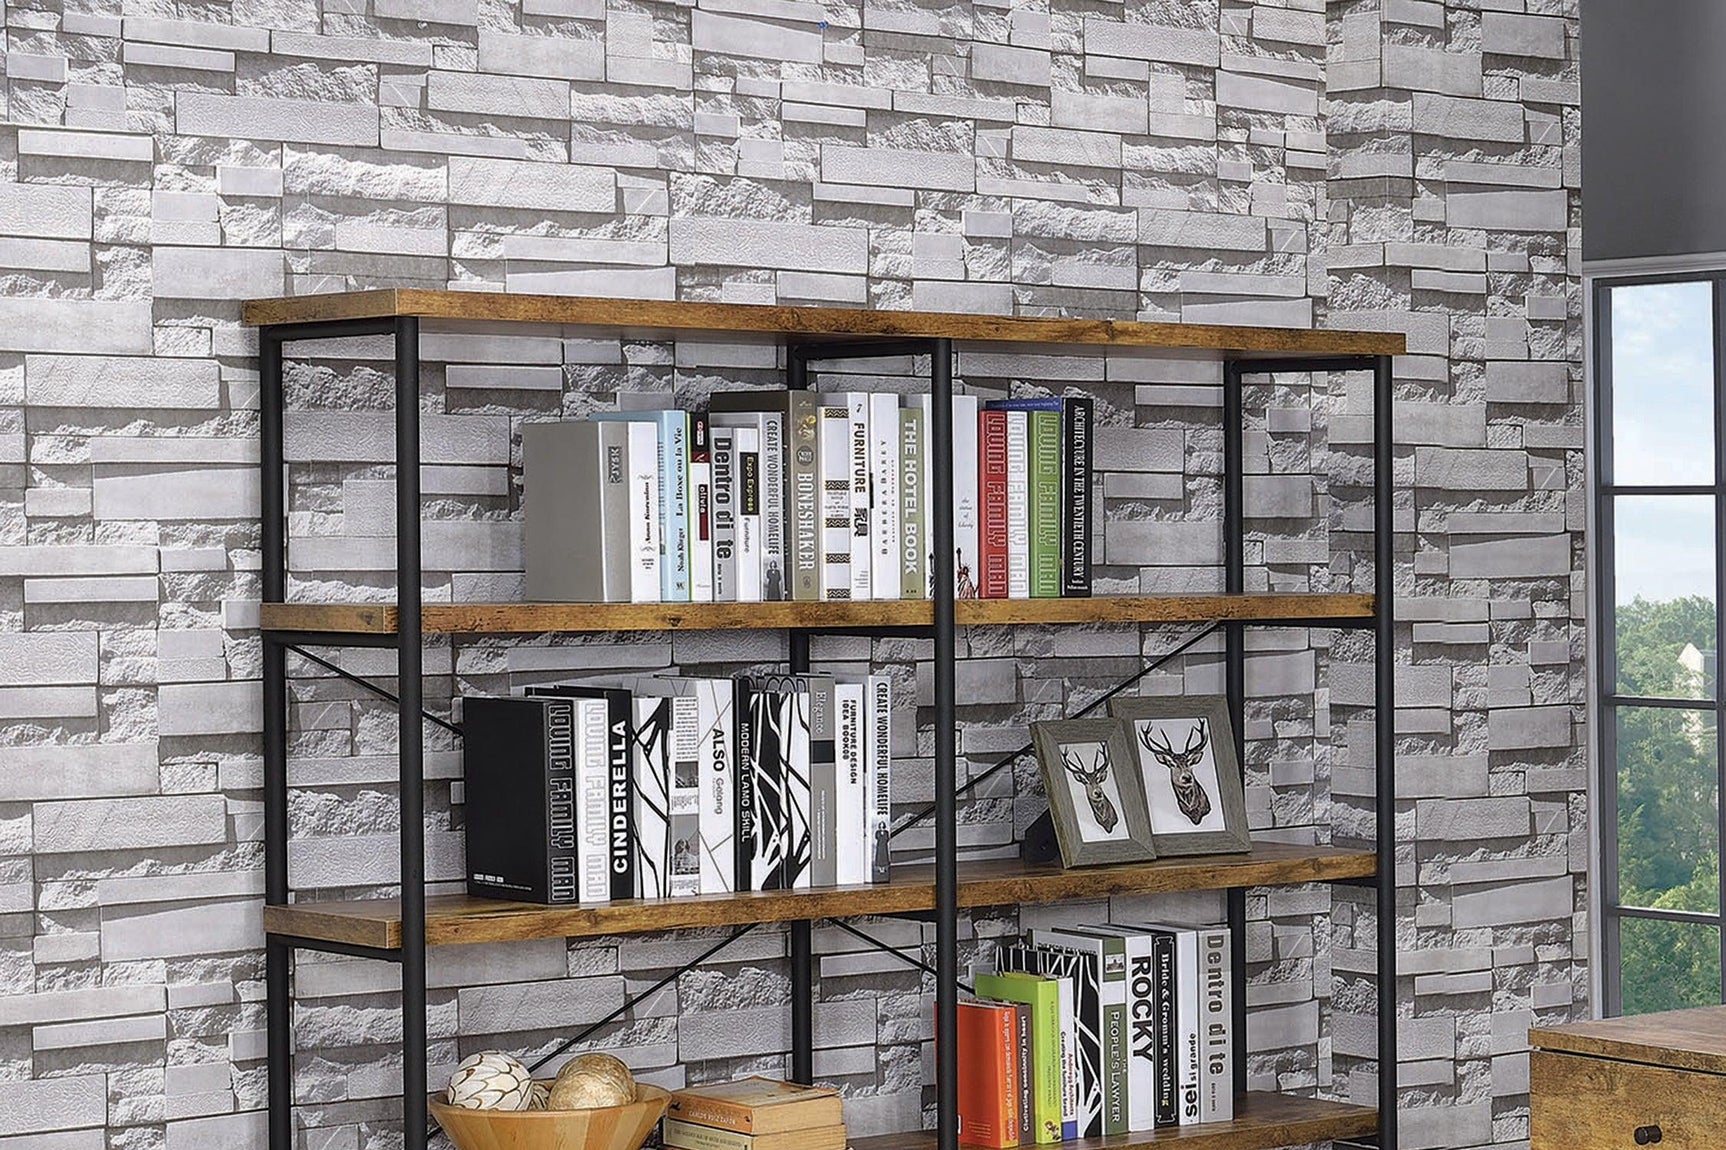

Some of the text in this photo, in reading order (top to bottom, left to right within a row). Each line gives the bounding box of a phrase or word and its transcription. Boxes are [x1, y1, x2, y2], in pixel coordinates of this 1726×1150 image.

[854, 422, 866, 494] FURNITURE
[904, 419, 917, 455] THE
[674, 428, 683, 516] La Boxe ou la Vie
[747, 456, 755, 512] Expo Express
[767, 420, 780, 556] CREATE WONDERFUL HOMELIFE
[905, 460, 917, 518] HOTEL
[1074, 468, 1084, 476] IN
[1074, 478, 1084, 493] THE
[714, 437, 734, 560] Dentro di te
[798, 472, 816, 570] BONESHAKER
[987, 482, 1006, 548] FAMILY
[1009, 480, 1026, 546] FAMILY
[1038, 482, 1057, 546] FAMILY
[1073, 494, 1084, 540] TWENTIETH
[744, 517, 752, 553] Furniture
[904, 528, 917, 576] BOOK
[1072, 540, 1084, 578] CENTURY
[988, 554, 1006, 595] MAN
[1010, 553, 1026, 592] MAN
[1039, 554, 1057, 594] MAN
[812, 691, 828, 734] Elegance
[842, 699, 850, 720] IDEA
[712, 728, 725, 772] ALSO
[740, 722, 750, 772] MODERN
[876, 682, 889, 816] CREATE WONDERFUL HOMELIFE
[550, 778, 574, 850] FAMILY
[586, 776, 607, 846] FAMILY
[612, 720, 628, 874] CINDERELLA
[715, 778, 724, 815] Golang
[740, 810, 750, 843] SKILL
[551, 856, 574, 902] MAN
[586, 853, 607, 898] MAN
[1161, 953, 1171, 986] Bride
[1131, 956, 1155, 1064] ROCKY
[1161, 988, 1170, 1000] &
[1207, 935, 1228, 1076] Dentro di te
[1110, 1012, 1121, 1122] PEOPLE'S LAWYER
[1160, 1058, 1171, 1106] wedding
[1180, 1032, 1198, 1117] sei si grande
